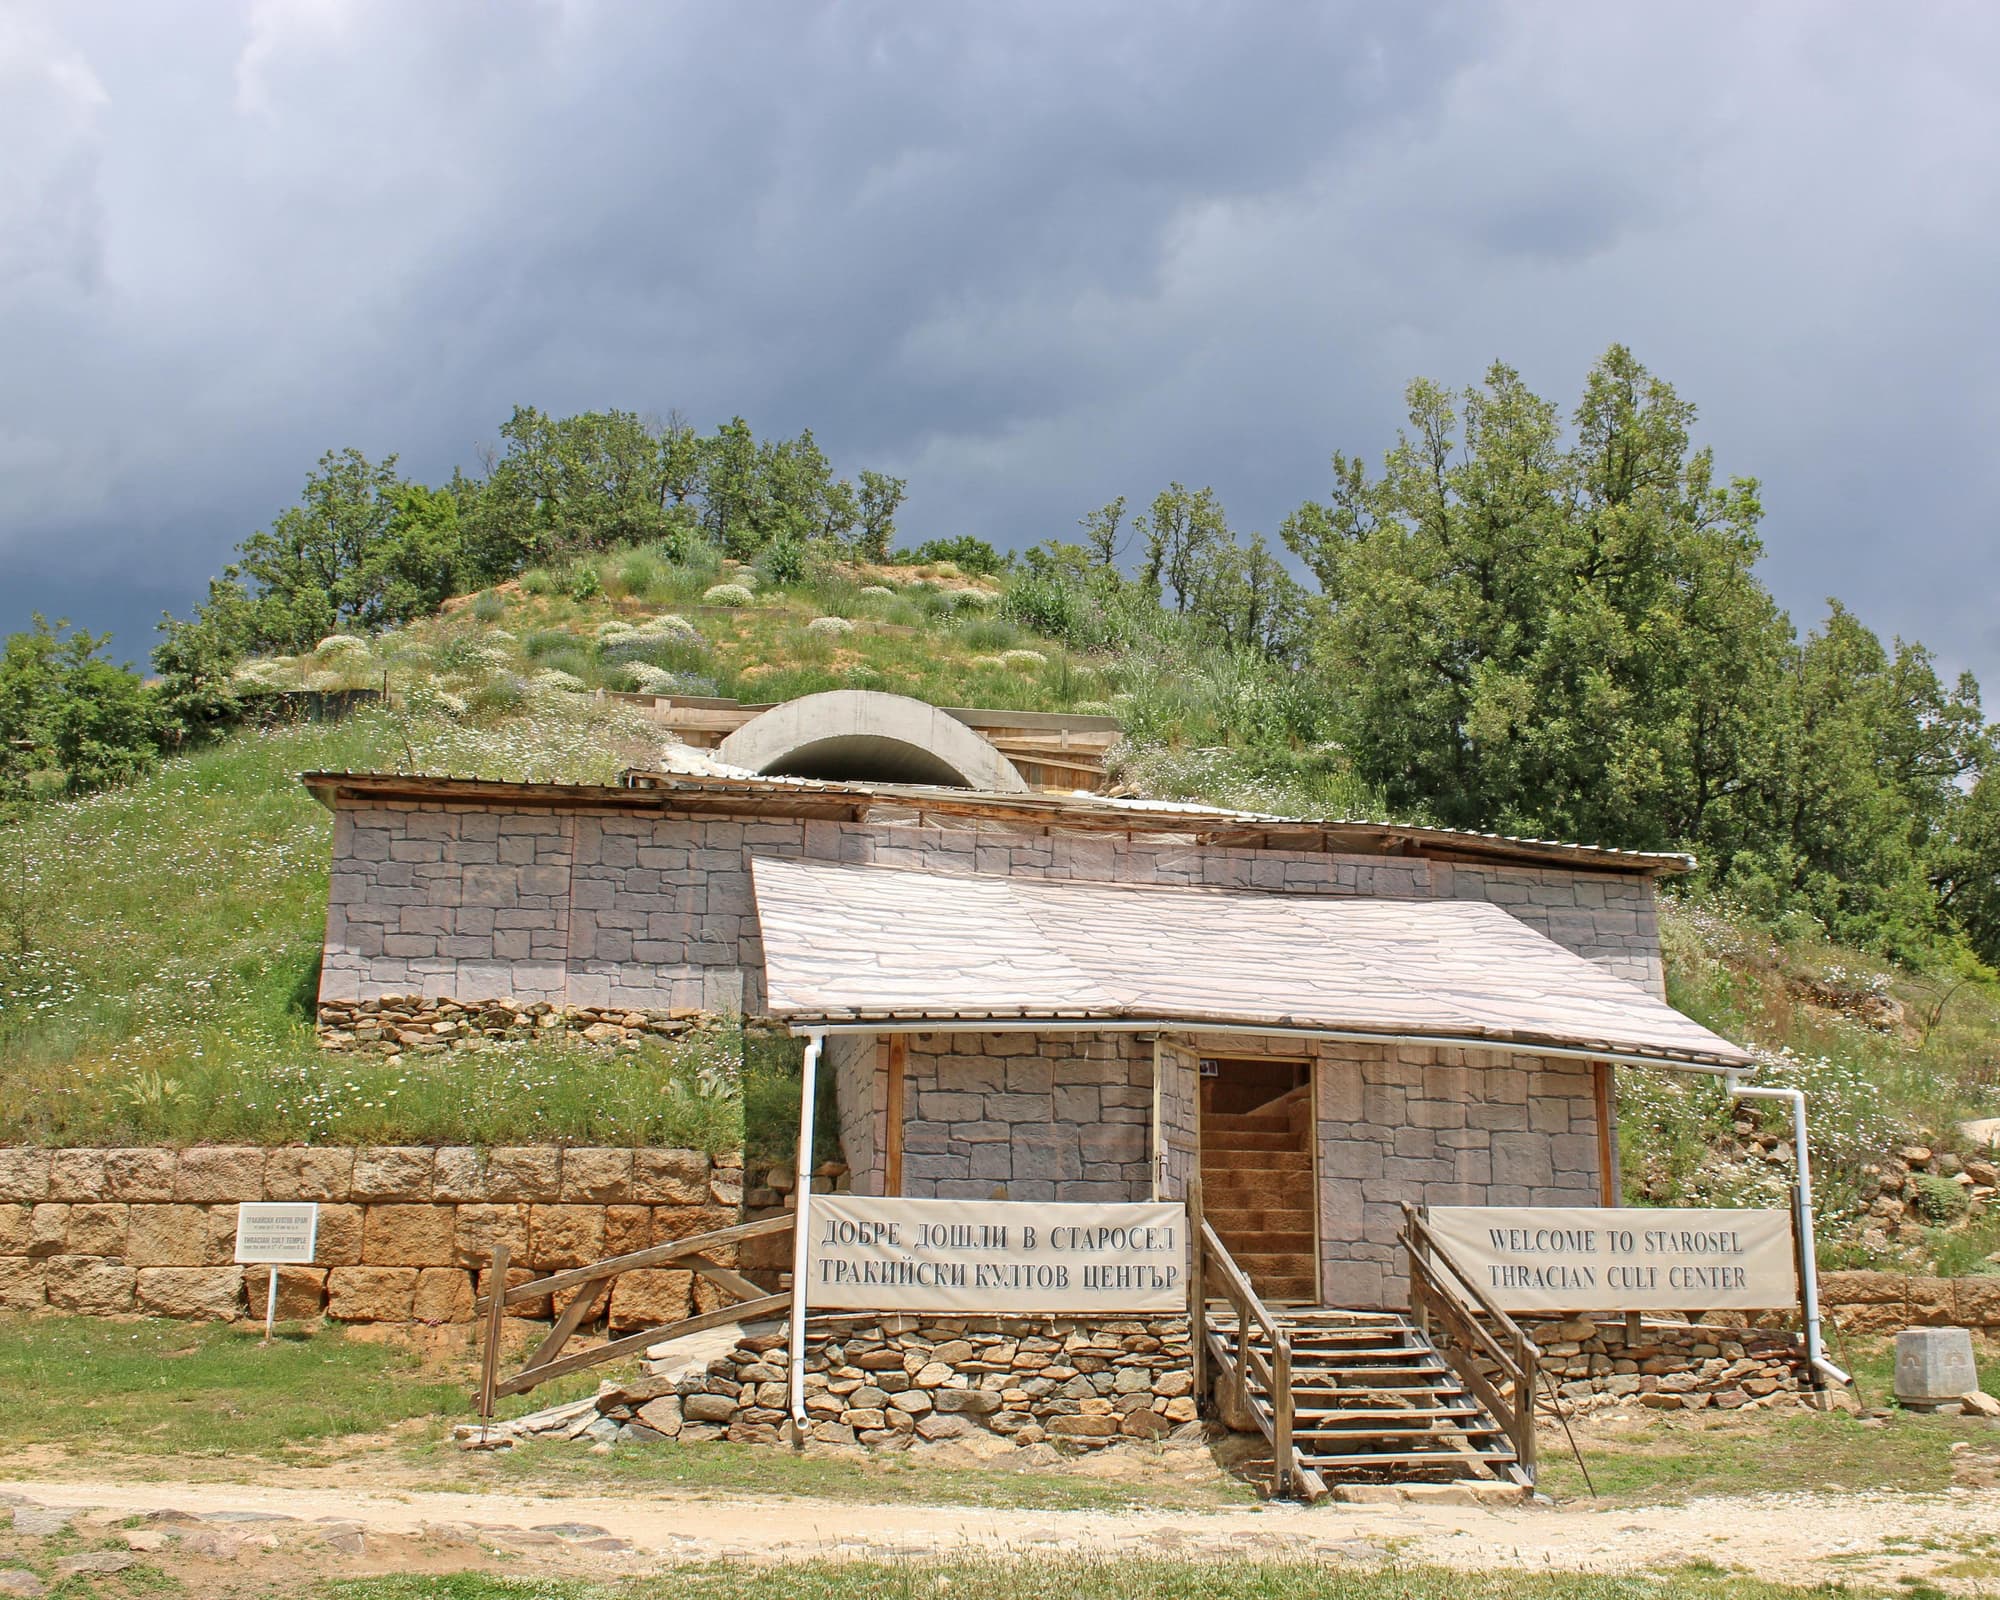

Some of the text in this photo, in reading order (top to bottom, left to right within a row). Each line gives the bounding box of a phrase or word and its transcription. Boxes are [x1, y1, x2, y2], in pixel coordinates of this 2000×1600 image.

[821, 1219, 1174, 1251] ДОБРЕ ДОШЛИ В СТАРОСЕЛ
[1489, 1228, 1743, 1254] WELCOME TO STAROSEL
[819, 1256, 1179, 1291] ТРАКИЙСКИ КУЛТОВ ЦЕНТЪР
[1488, 1264, 1746, 1290] THRACIAN CULT CENTER
